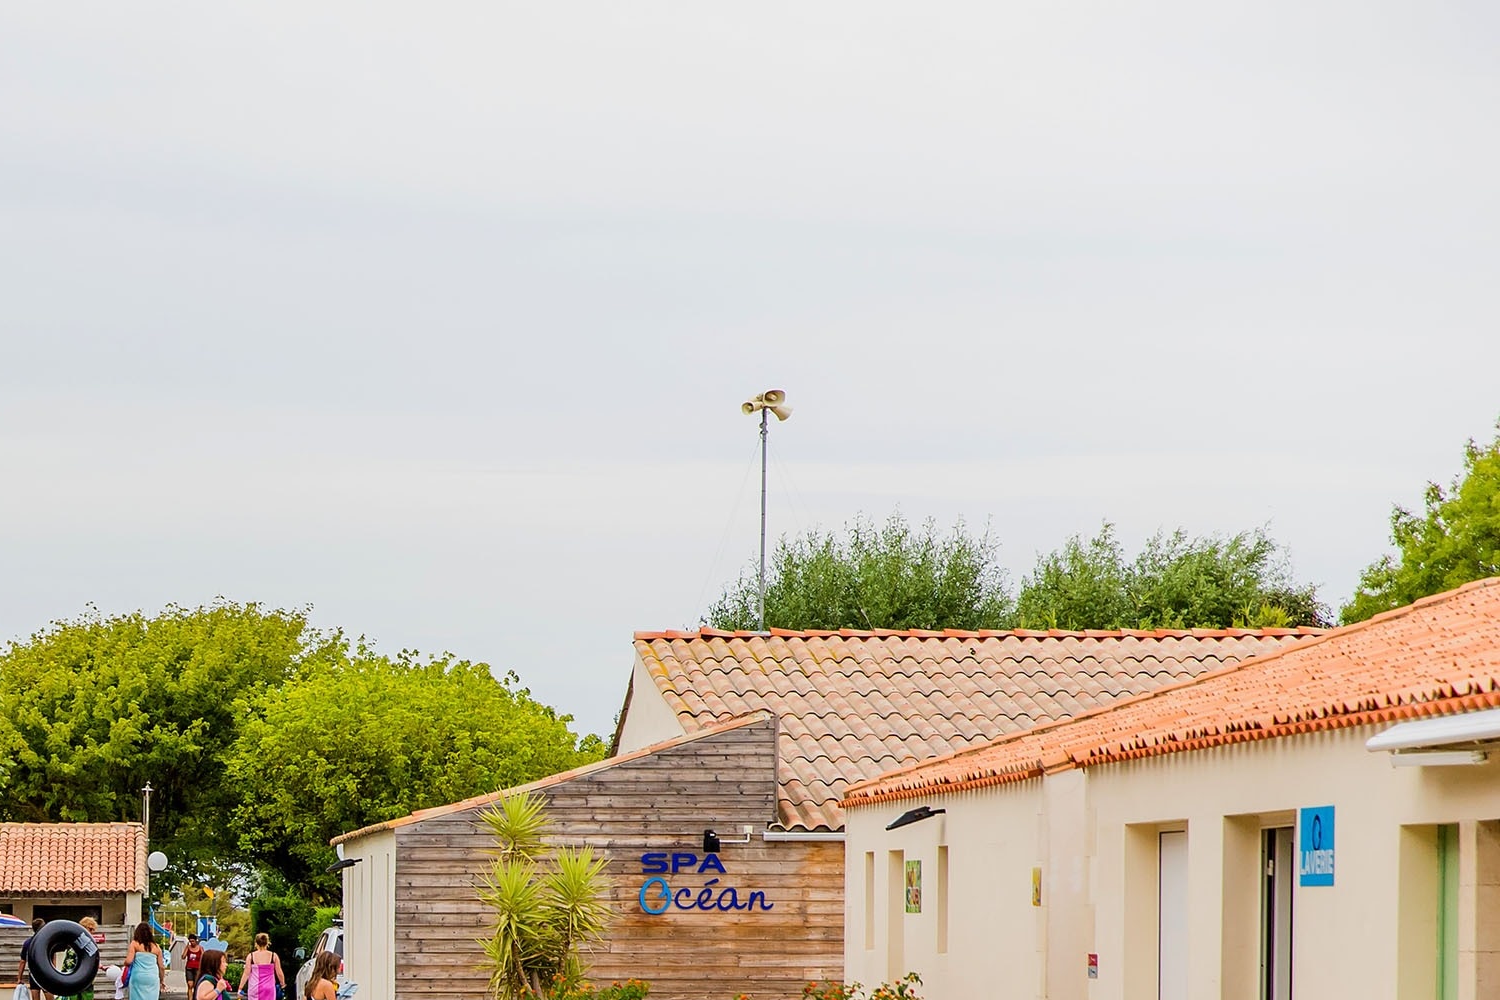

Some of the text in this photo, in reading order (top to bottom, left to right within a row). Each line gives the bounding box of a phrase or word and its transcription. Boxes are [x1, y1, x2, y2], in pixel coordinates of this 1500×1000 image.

[641, 852, 727, 874] SPA
[1300, 849, 1334, 875] LAVERIE
[639, 876, 774, 915] Océan
